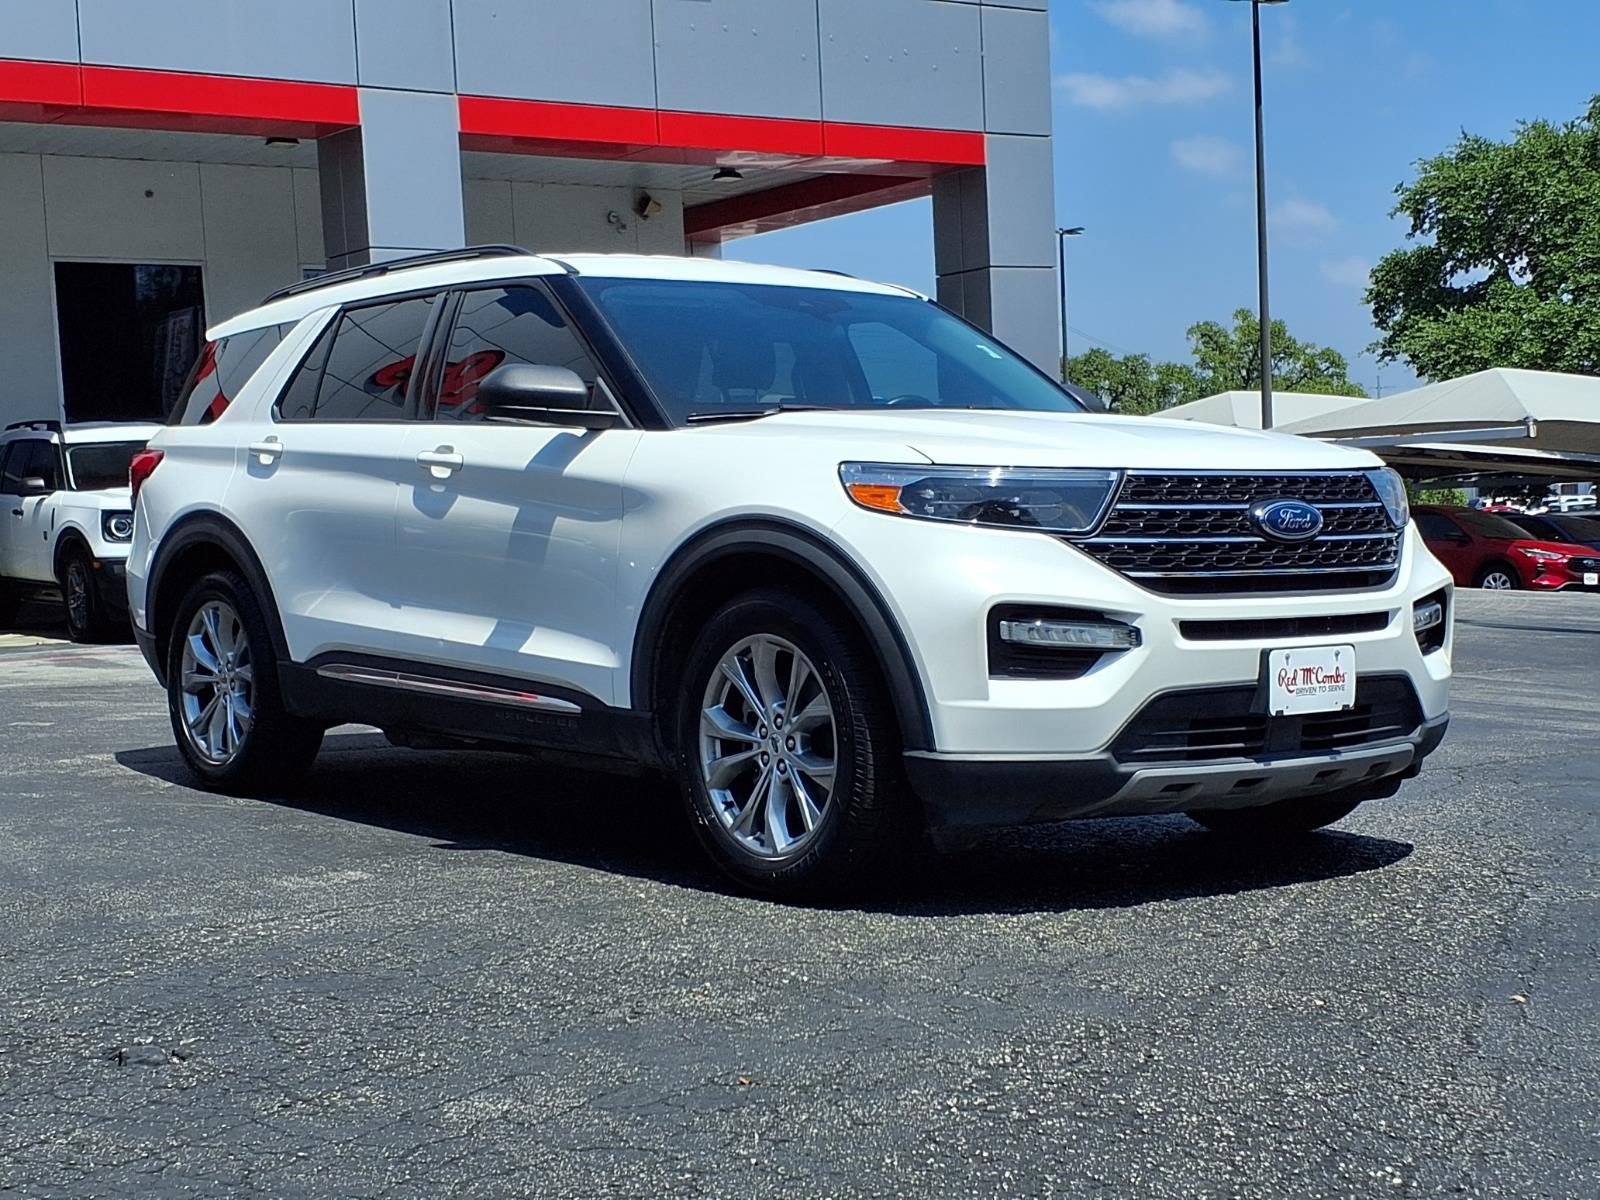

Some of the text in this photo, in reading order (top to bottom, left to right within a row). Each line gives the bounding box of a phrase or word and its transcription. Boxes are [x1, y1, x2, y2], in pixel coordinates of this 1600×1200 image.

[1278, 508, 1311, 529] Ford
[1278, 666, 1345, 694] Red McCombs
[1328, 684, 1345, 692] SERVE
